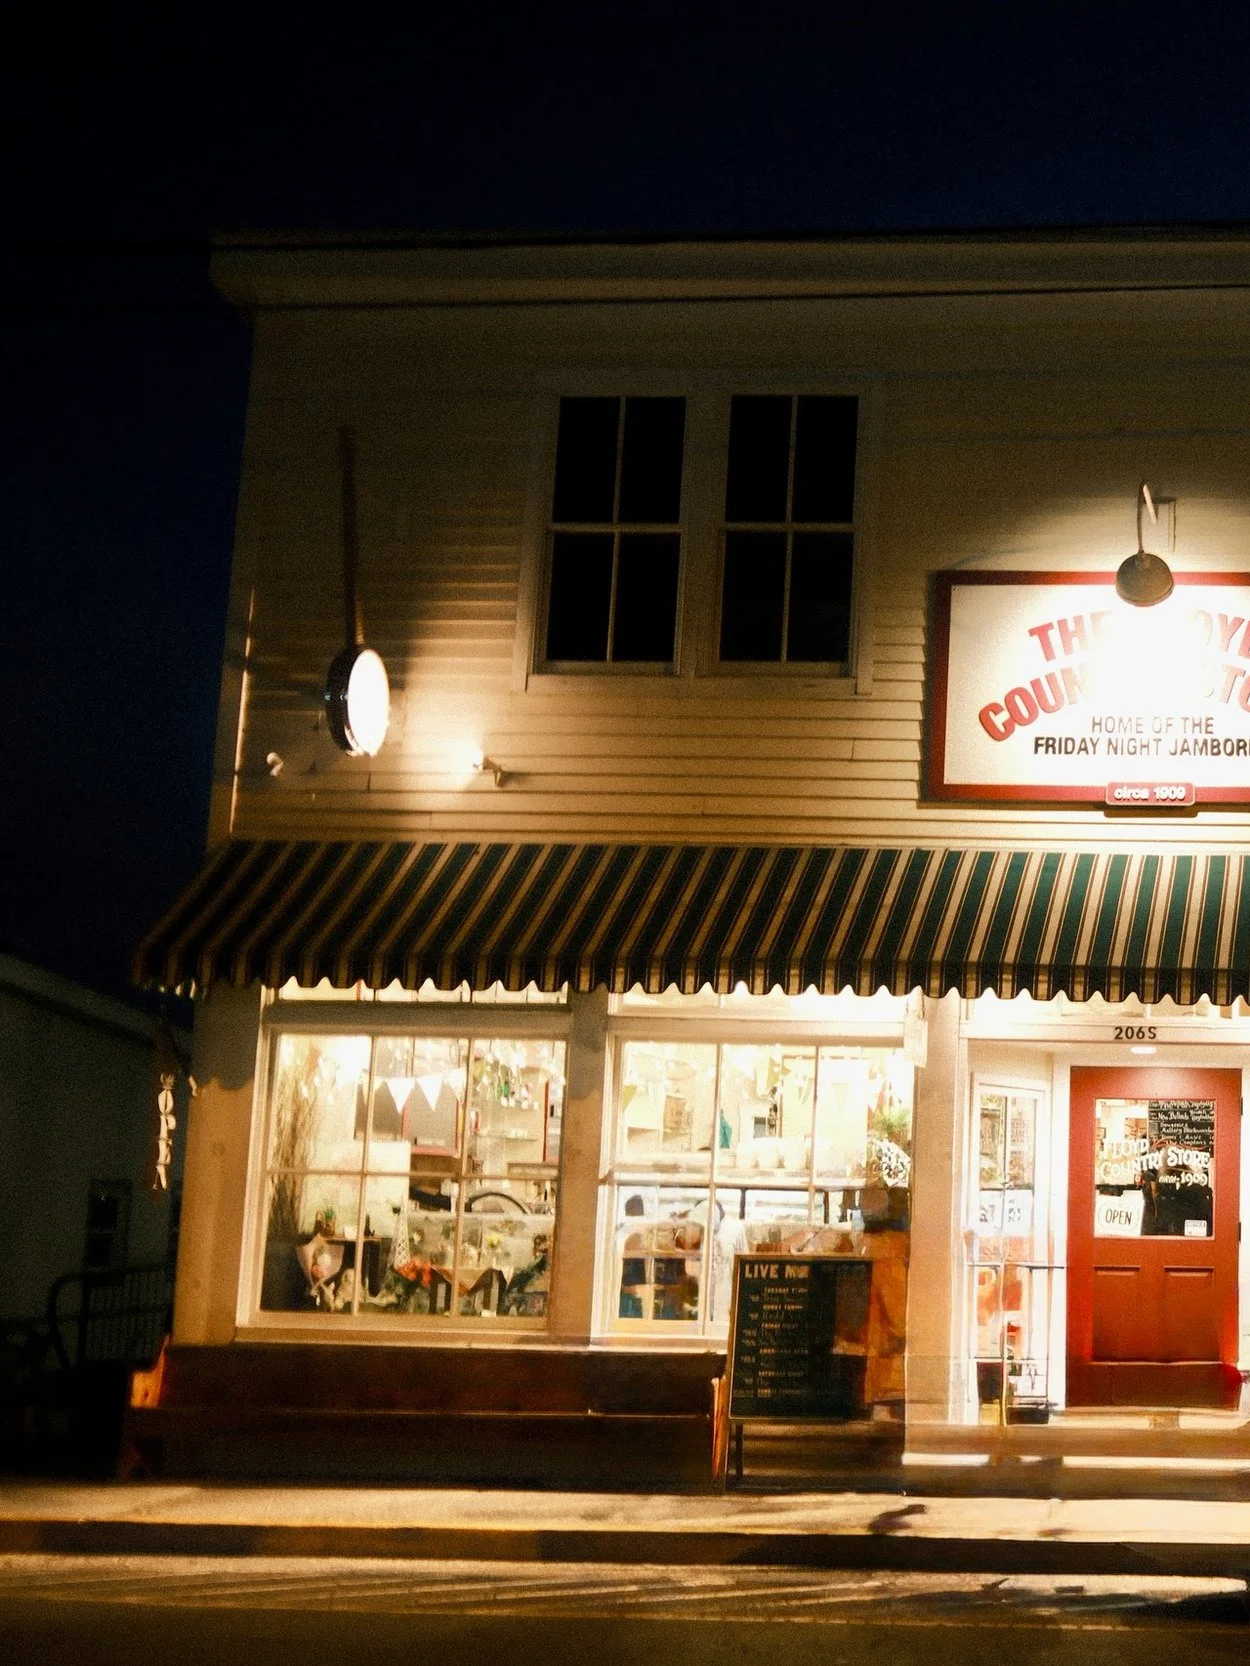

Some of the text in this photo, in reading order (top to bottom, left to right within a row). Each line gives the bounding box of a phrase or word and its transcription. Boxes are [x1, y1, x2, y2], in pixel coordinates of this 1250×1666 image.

[978, 664, 1094, 742] COUN
[1091, 716, 1215, 735] HOME OF THE
[1033, 736, 1100, 755] FRIDAY
[1106, 737, 1163, 756] NIGHT
[1113, 785, 1187, 801] circa 1909
[1167, 1146, 1210, 1169] STORE
[1105, 1208, 1133, 1226] OPEN
[744, 1263, 779, 1279] LIVE
